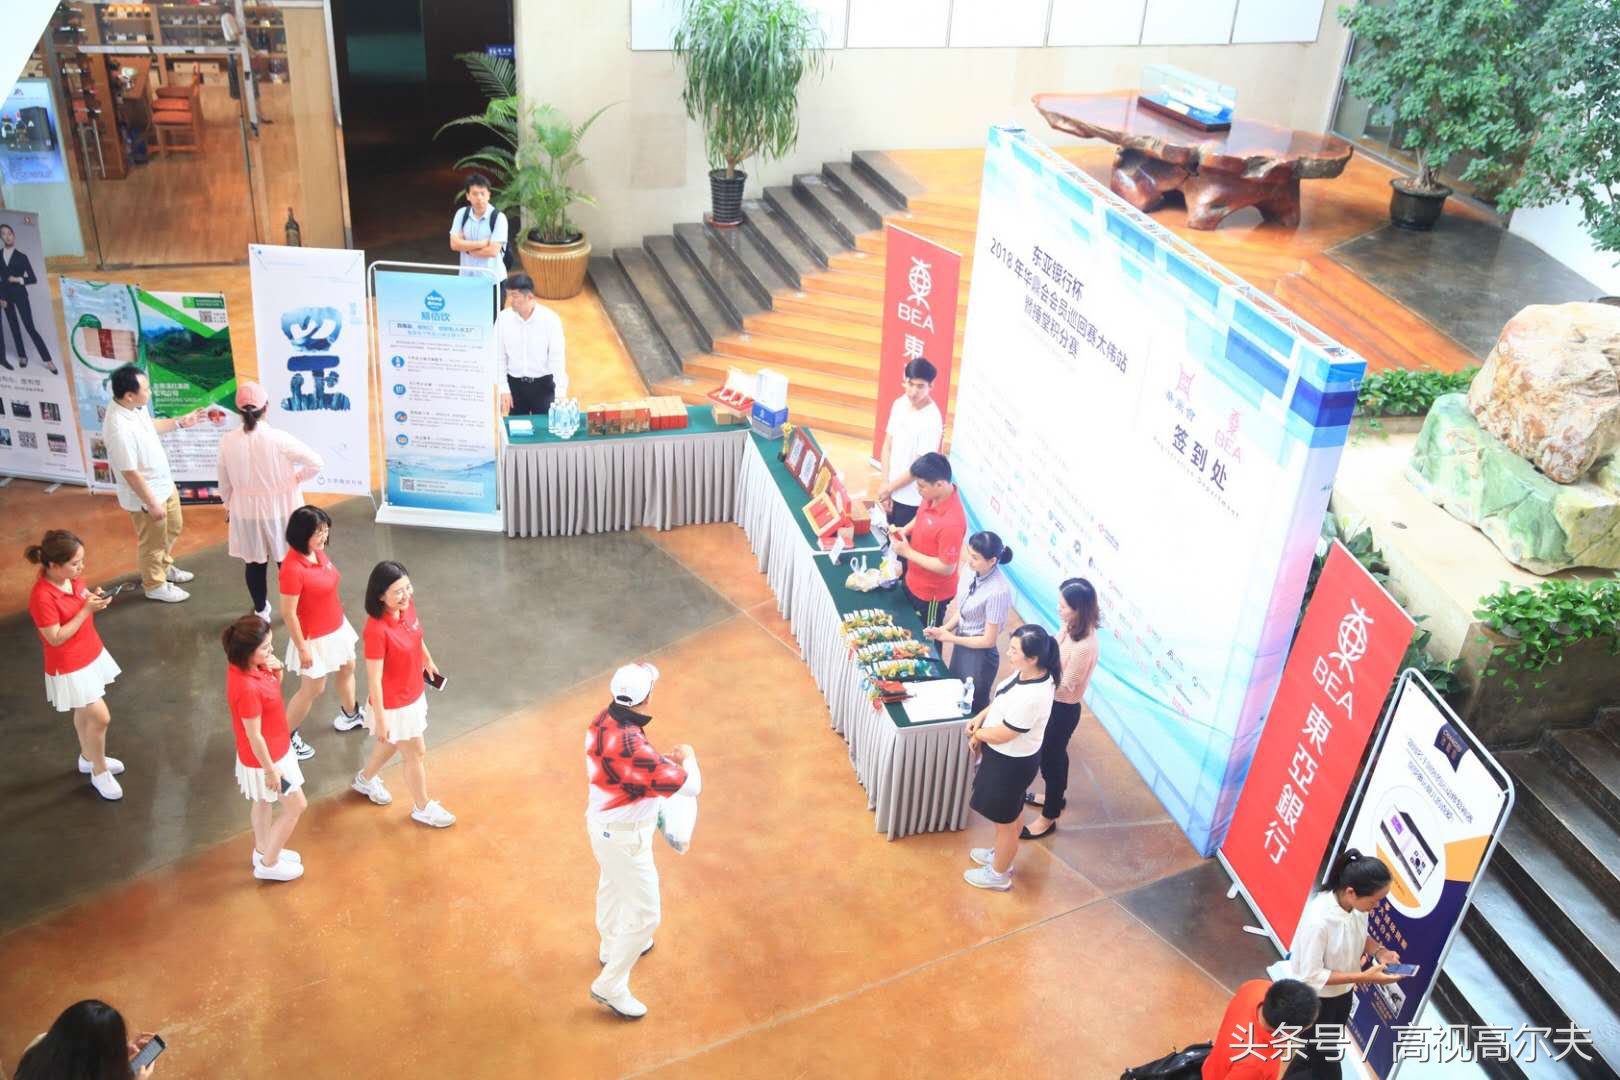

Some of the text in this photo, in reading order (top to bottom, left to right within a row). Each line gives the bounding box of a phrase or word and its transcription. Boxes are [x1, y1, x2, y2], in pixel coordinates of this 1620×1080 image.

[990, 237, 1014, 269] 2018
[1032, 244, 1085, 302] 东亚银行杯
[897, 302, 935, 335] BEA
[1172, 424, 1227, 491] 签到处
[1215, 429, 1241, 464] BEA
[1312, 655, 1353, 721] BEA
[1264, 702, 1333, 865] 東亞銀行
